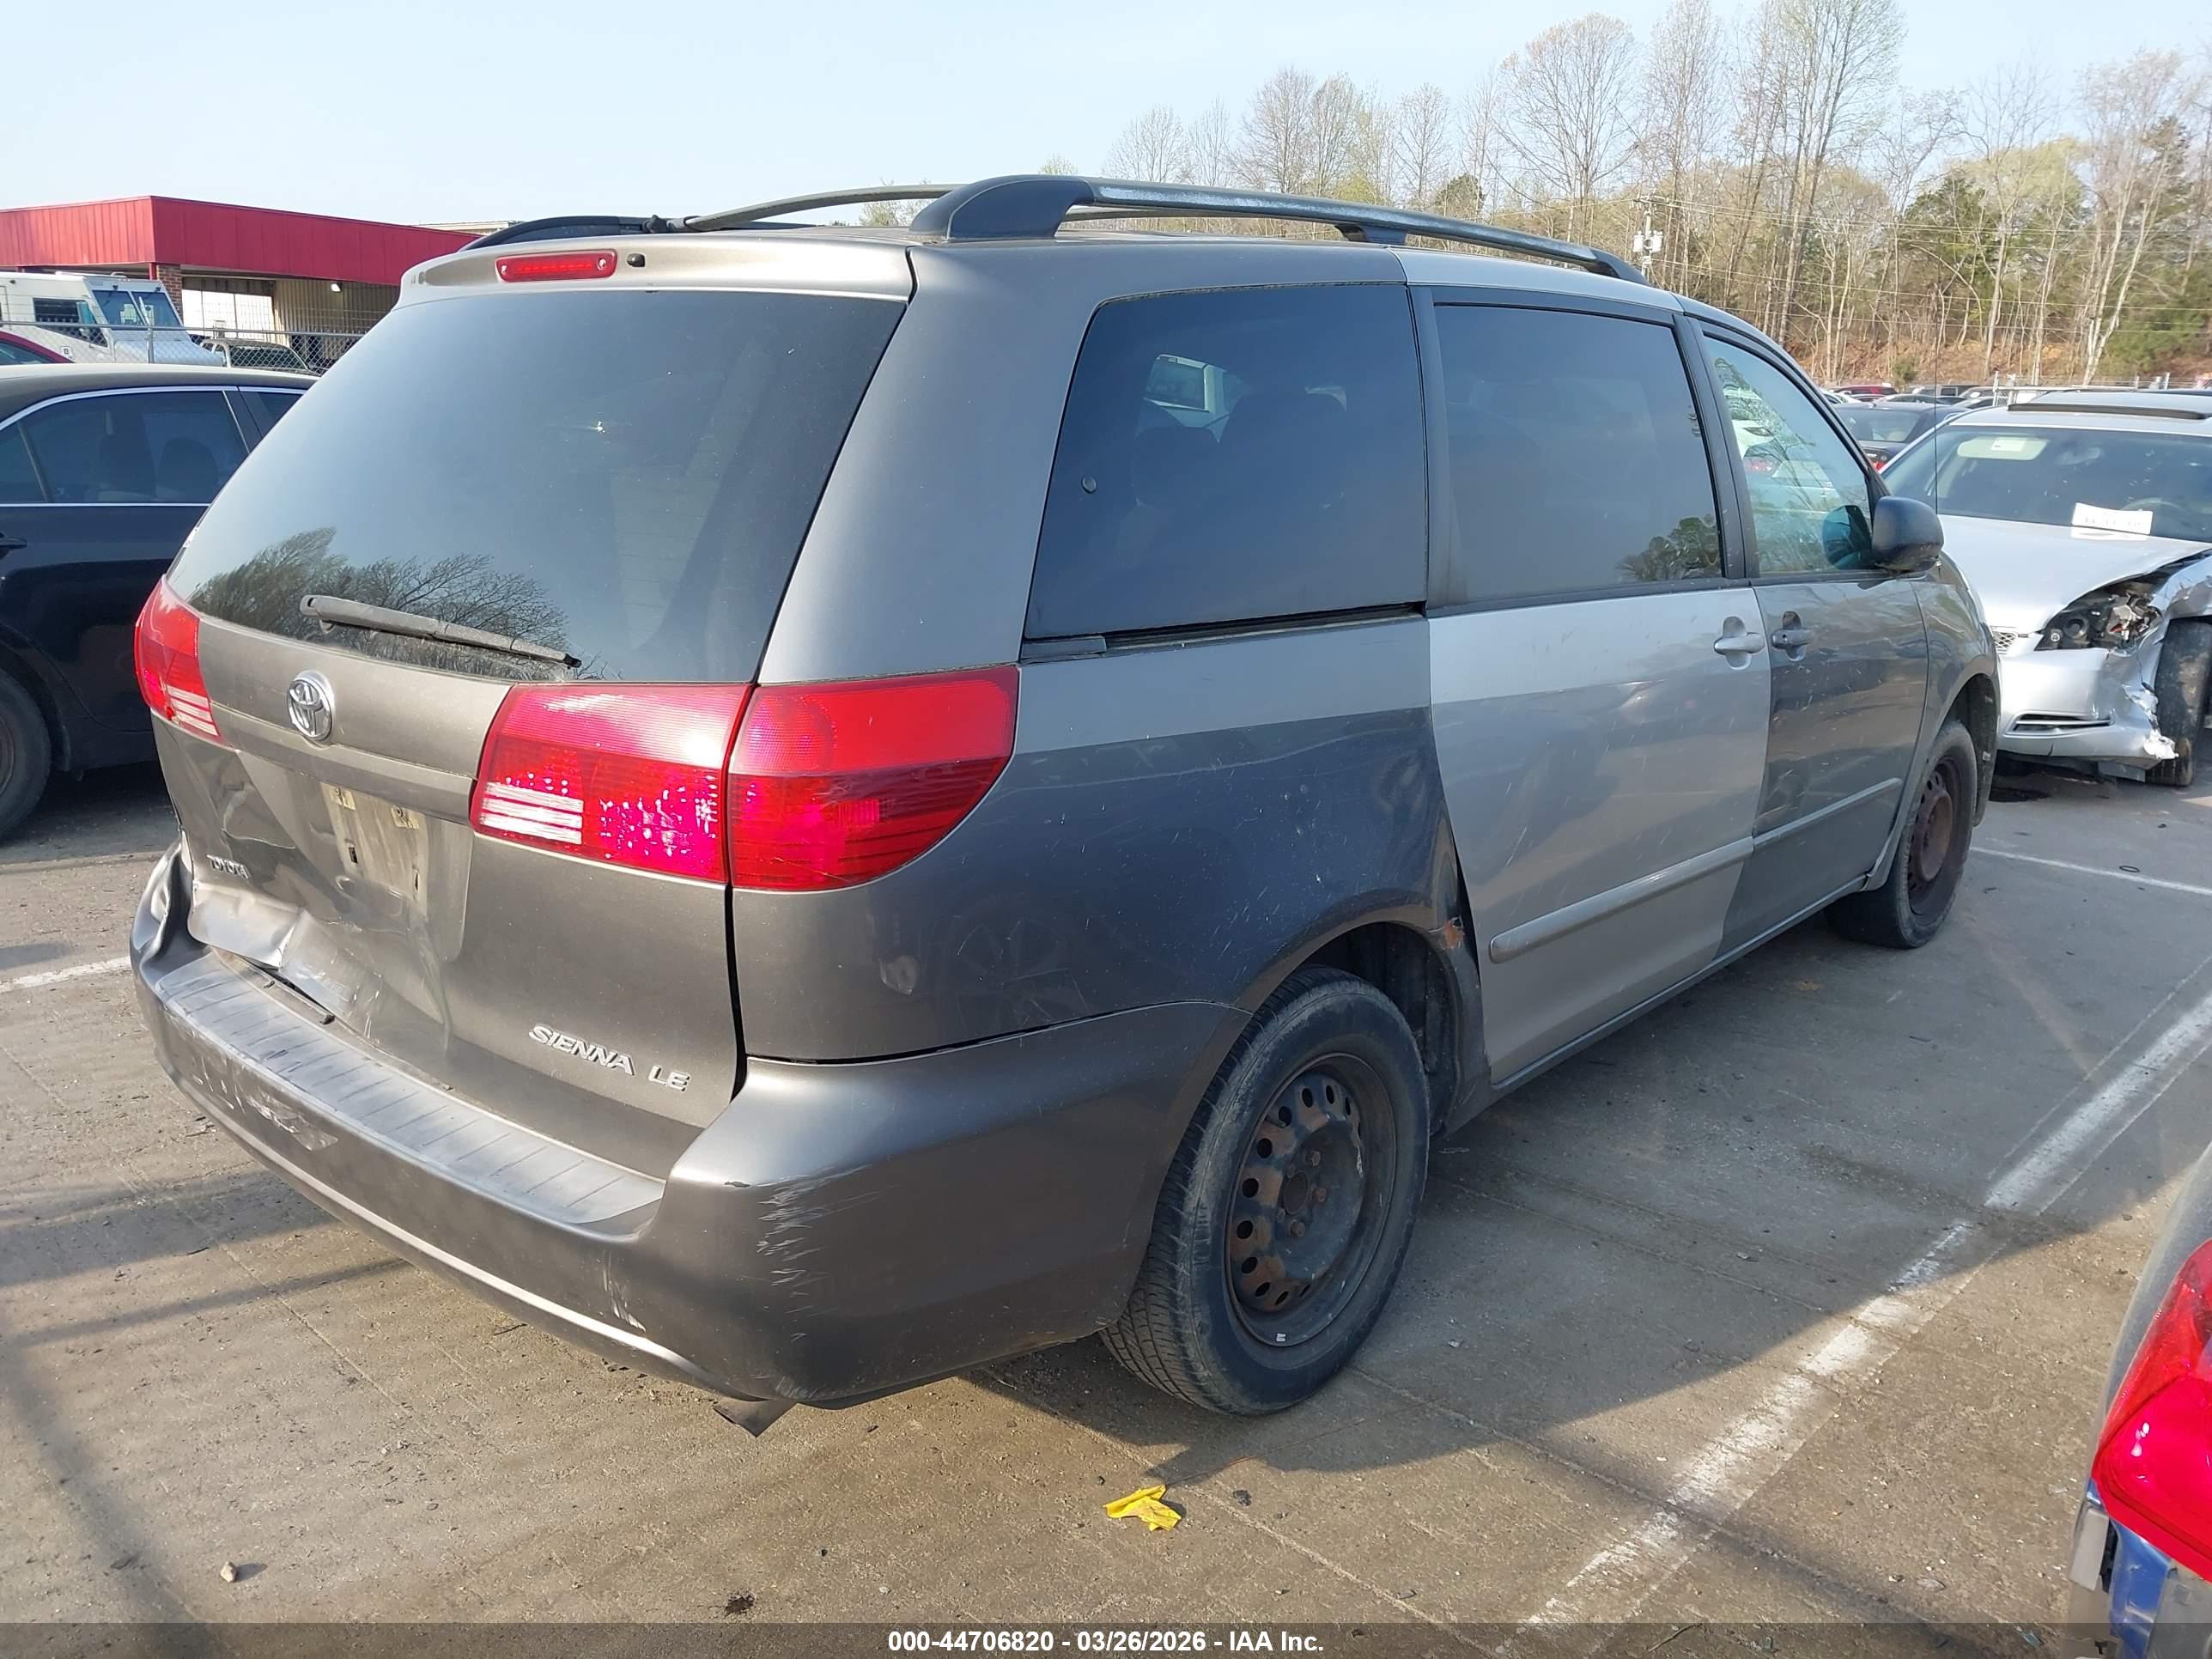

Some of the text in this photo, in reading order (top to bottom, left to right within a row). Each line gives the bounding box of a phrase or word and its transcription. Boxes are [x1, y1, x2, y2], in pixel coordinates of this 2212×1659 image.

[206, 854, 252, 879] TOYOTA
[528, 1024, 691, 1092] SIENNA LE
